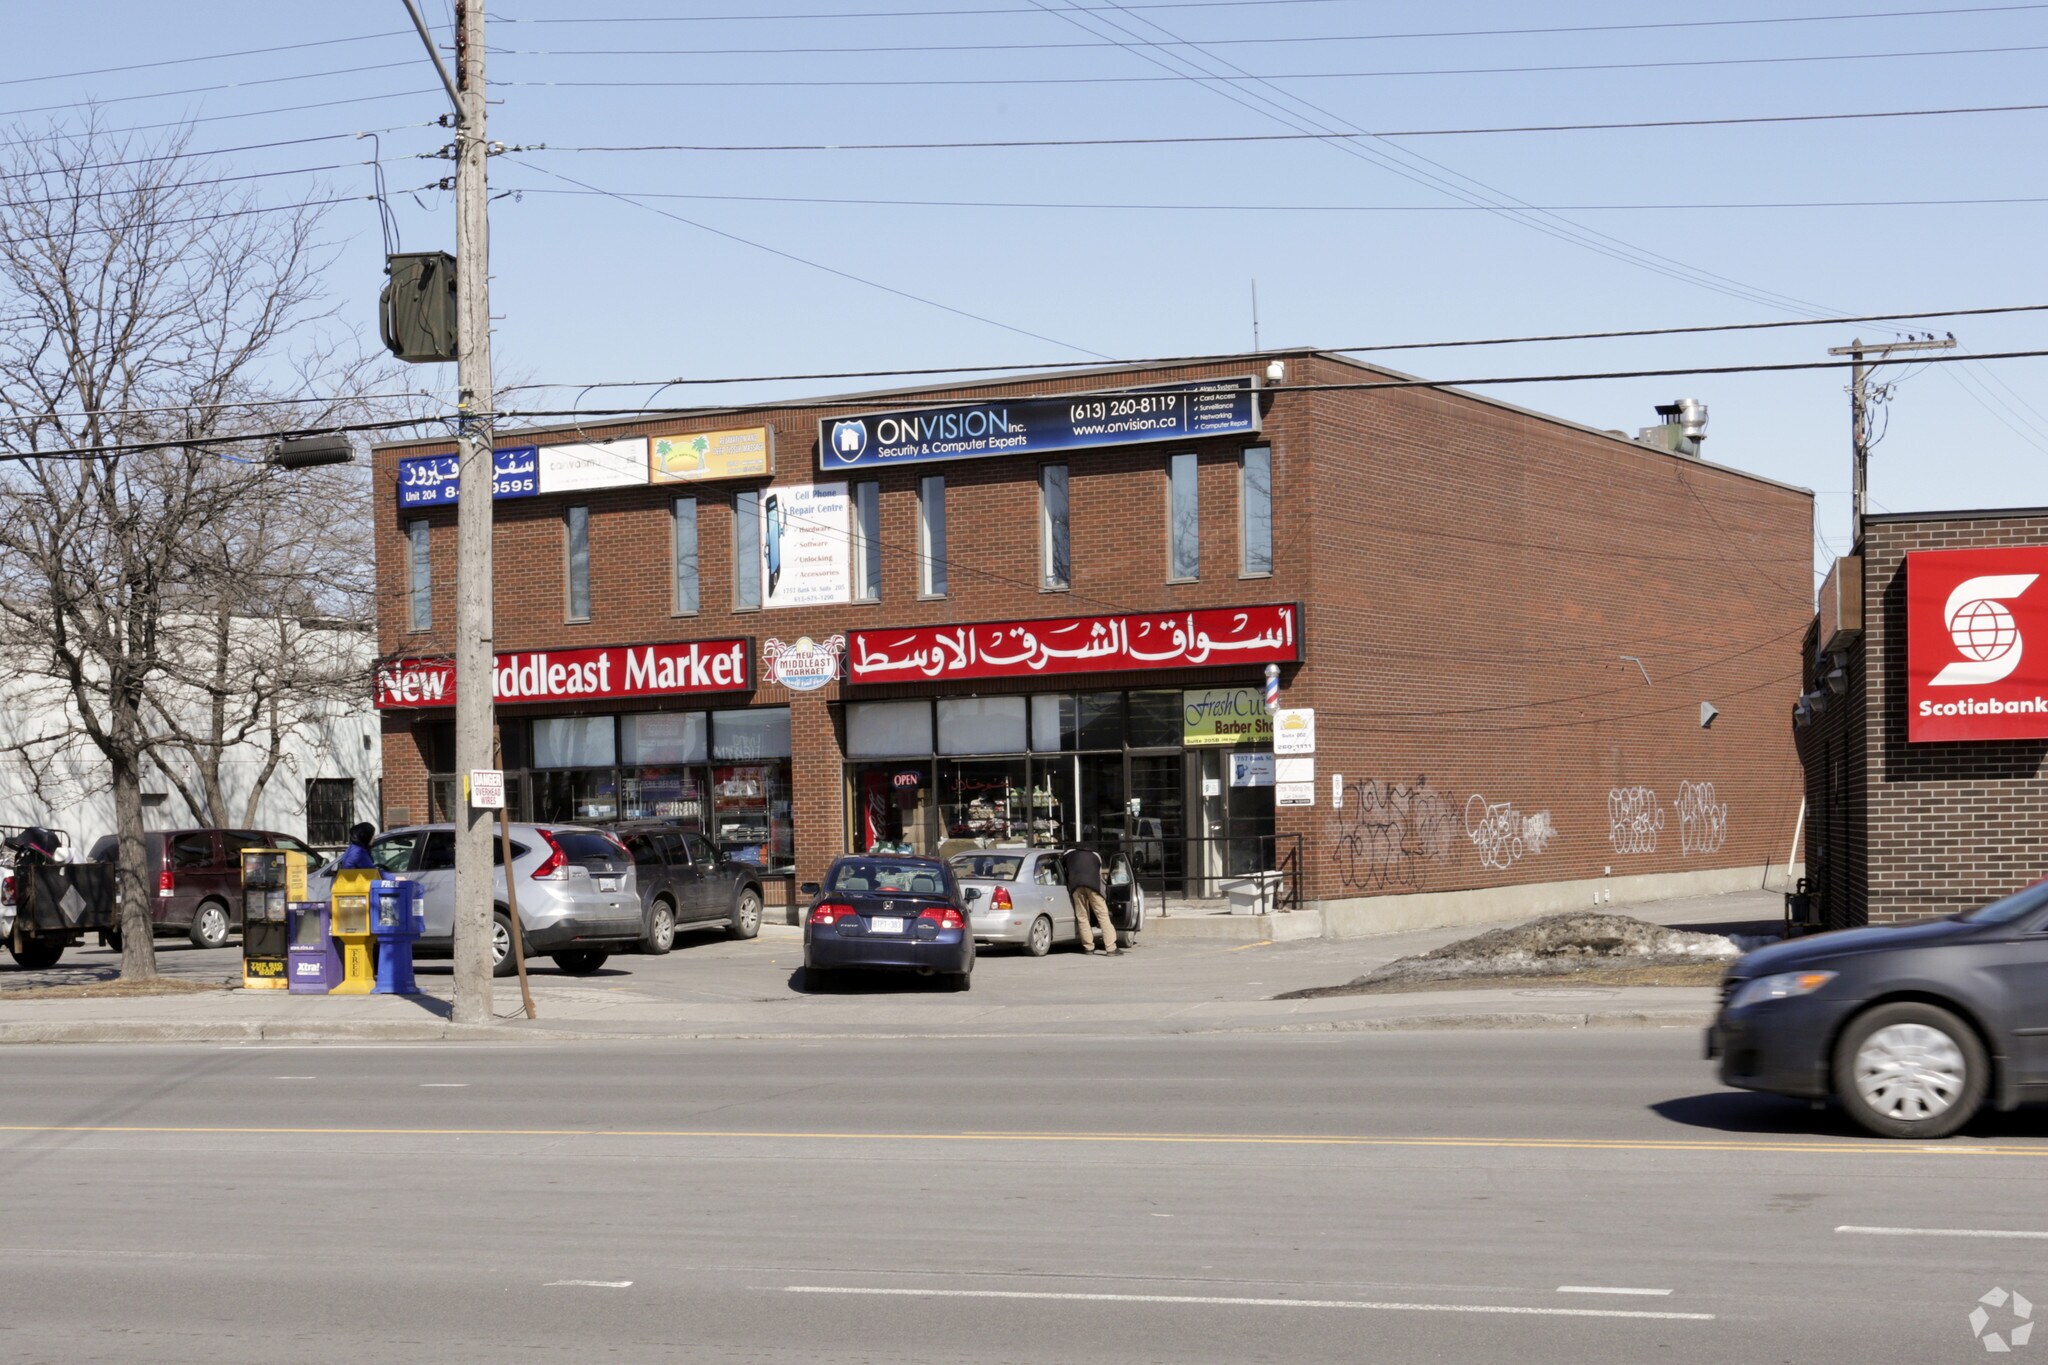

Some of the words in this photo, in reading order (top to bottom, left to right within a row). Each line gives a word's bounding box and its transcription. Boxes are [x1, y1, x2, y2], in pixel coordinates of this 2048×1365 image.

[1070, 402, 1106, 423] (613)
[1110, 396, 1176, 416] 260-8119
[1199, 403, 1234, 411] Surveillance
[1200, 412, 1232, 420] Networking
[877, 409, 1008, 444] ONVISION
[1008, 423, 1027, 433] Inc.
[1073, 416, 1177, 436] www.onvision.ca
[878, 446, 919, 458] Security
[921, 444, 930, 454] &
[932, 439, 986, 454] Computer
[988, 435, 1027, 449] Experts
[405, 491, 420, 502] Unit
[422, 490, 437, 500] 204
[795, 491, 809, 500] Cell
[813, 489, 837, 498] Phone
[790, 505, 815, 515] Repair
[817, 503, 844, 512] Centre
[799, 555, 833, 563] Unlocking
[800, 570, 839, 578] Accessories
[979, 618, 1128, 670] الشرق
[780, 658, 830, 669] MIDDLEAST
[378, 661, 448, 702] New
[493, 652, 611, 698] iddleast
[624, 643, 743, 690] Market
[1919, 697, 2048, 716] Scotiabank
[1215, 720, 1252, 735] Barber
[1255, 719, 1274, 733] Sho
[474, 773, 501, 787] DANGER
[894, 774, 918, 786] OPEN
[475, 787, 501, 797] OVERHEAD
[481, 796, 496, 805] WIRES
